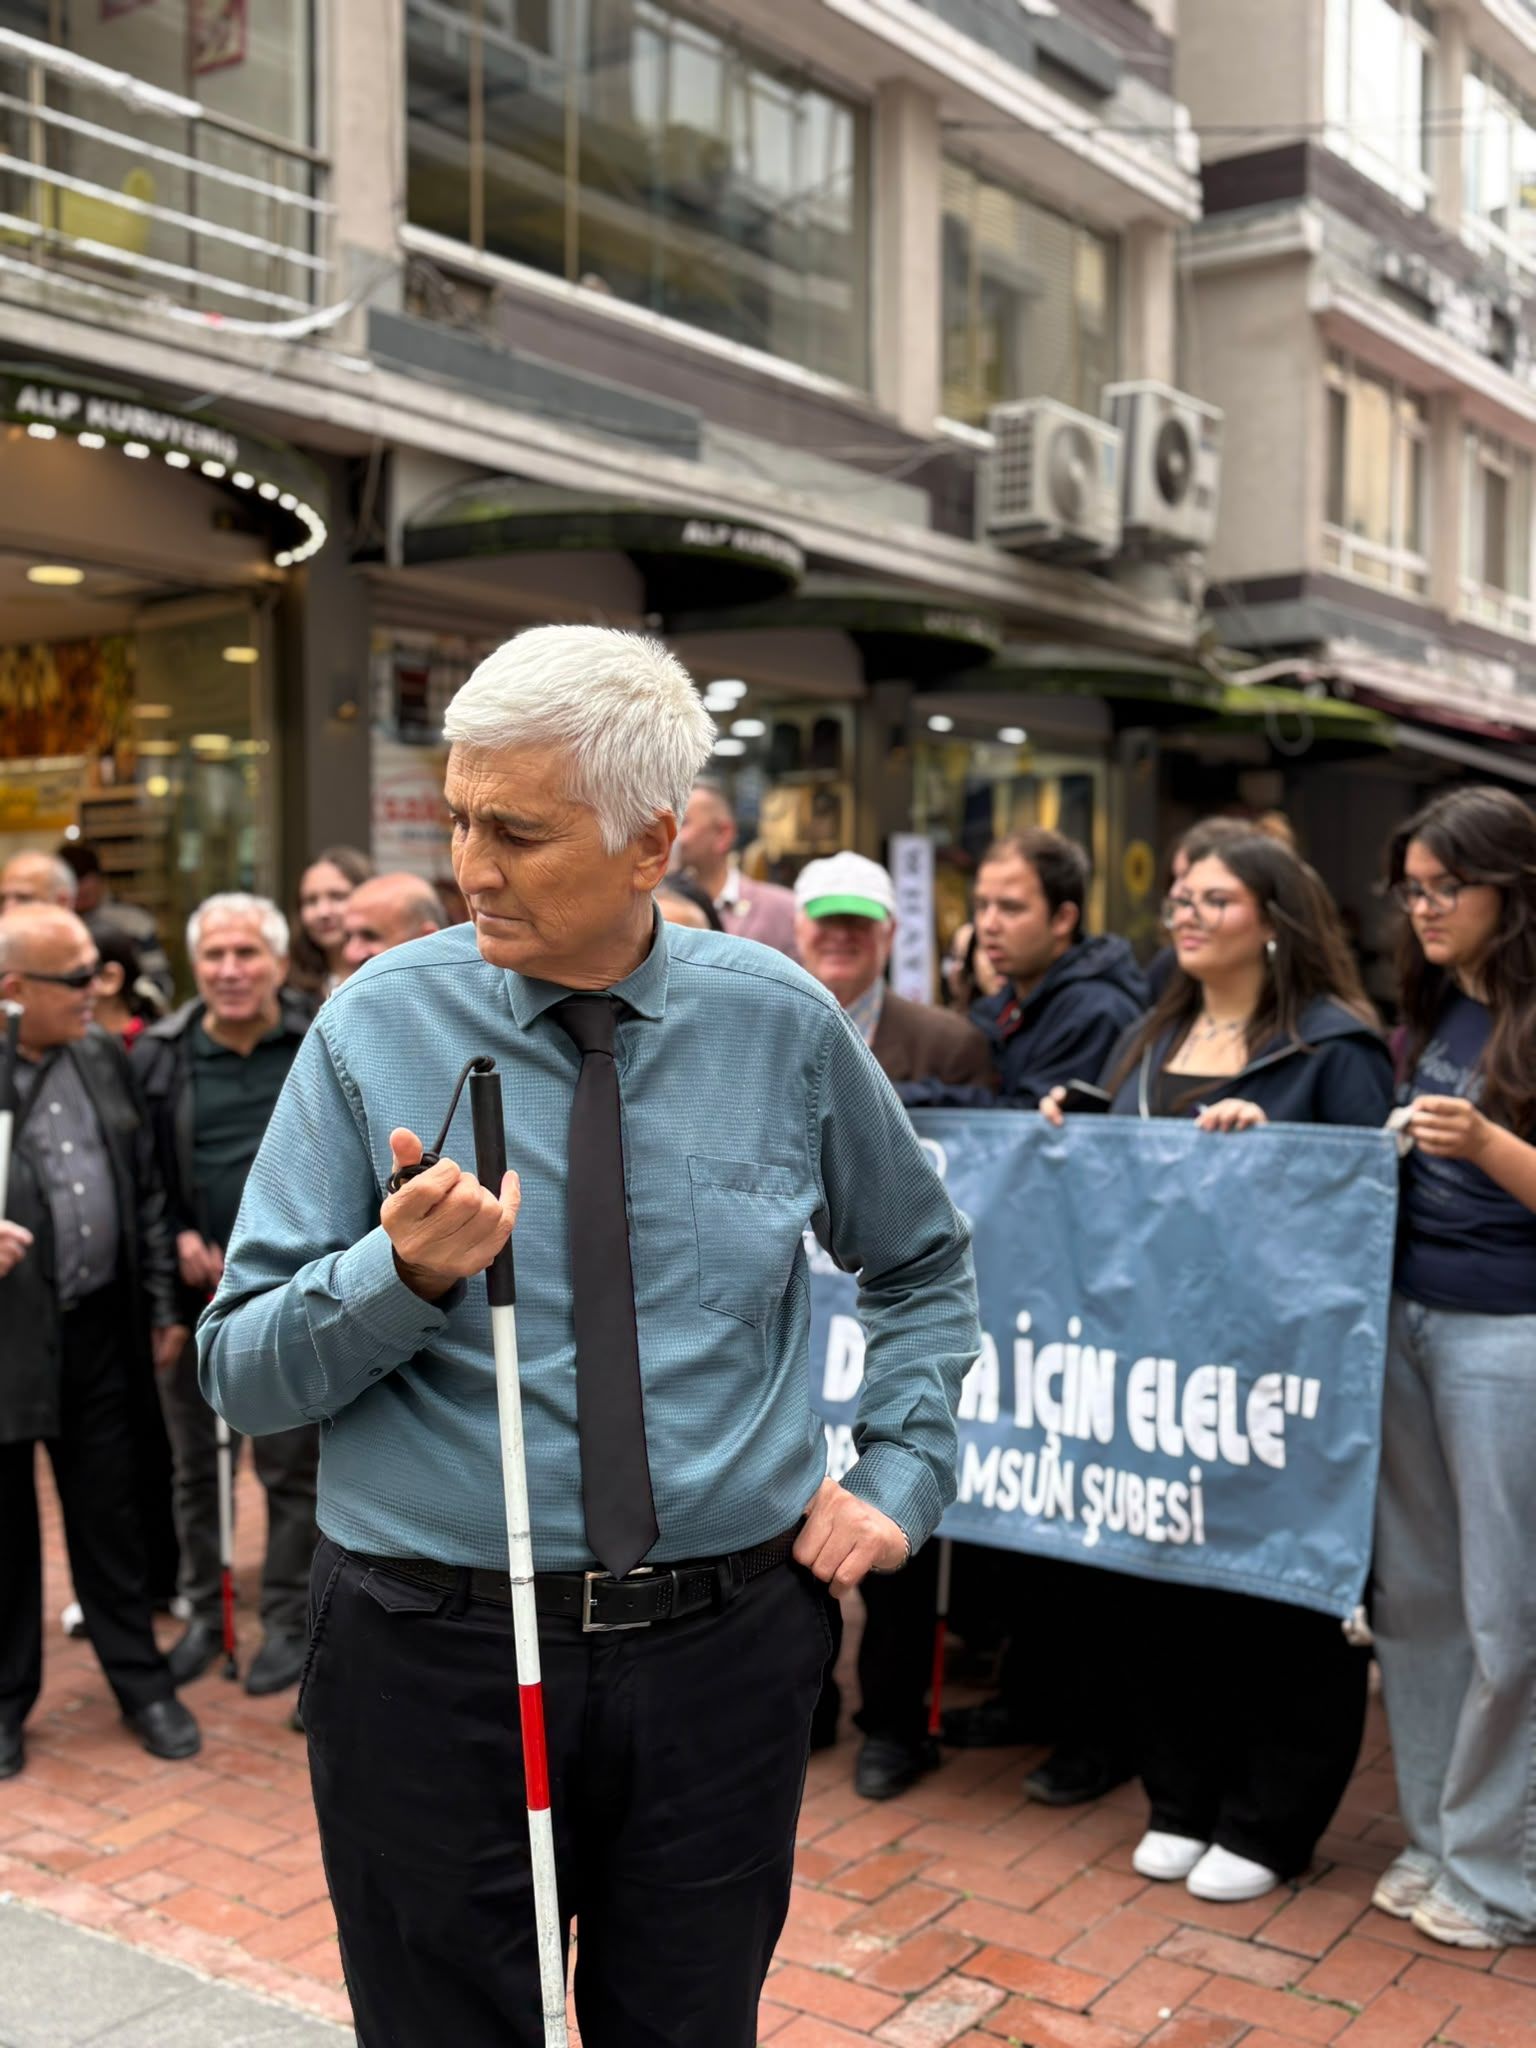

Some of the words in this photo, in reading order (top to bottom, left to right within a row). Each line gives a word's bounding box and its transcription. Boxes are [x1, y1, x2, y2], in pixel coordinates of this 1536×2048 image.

[16, 384, 81, 420] ALP
[1013, 1310, 1117, 1457] İÇİN
[957, 1440, 1075, 1523] MSUN
[1080, 1464, 1206, 1548] ŞUBESİ
